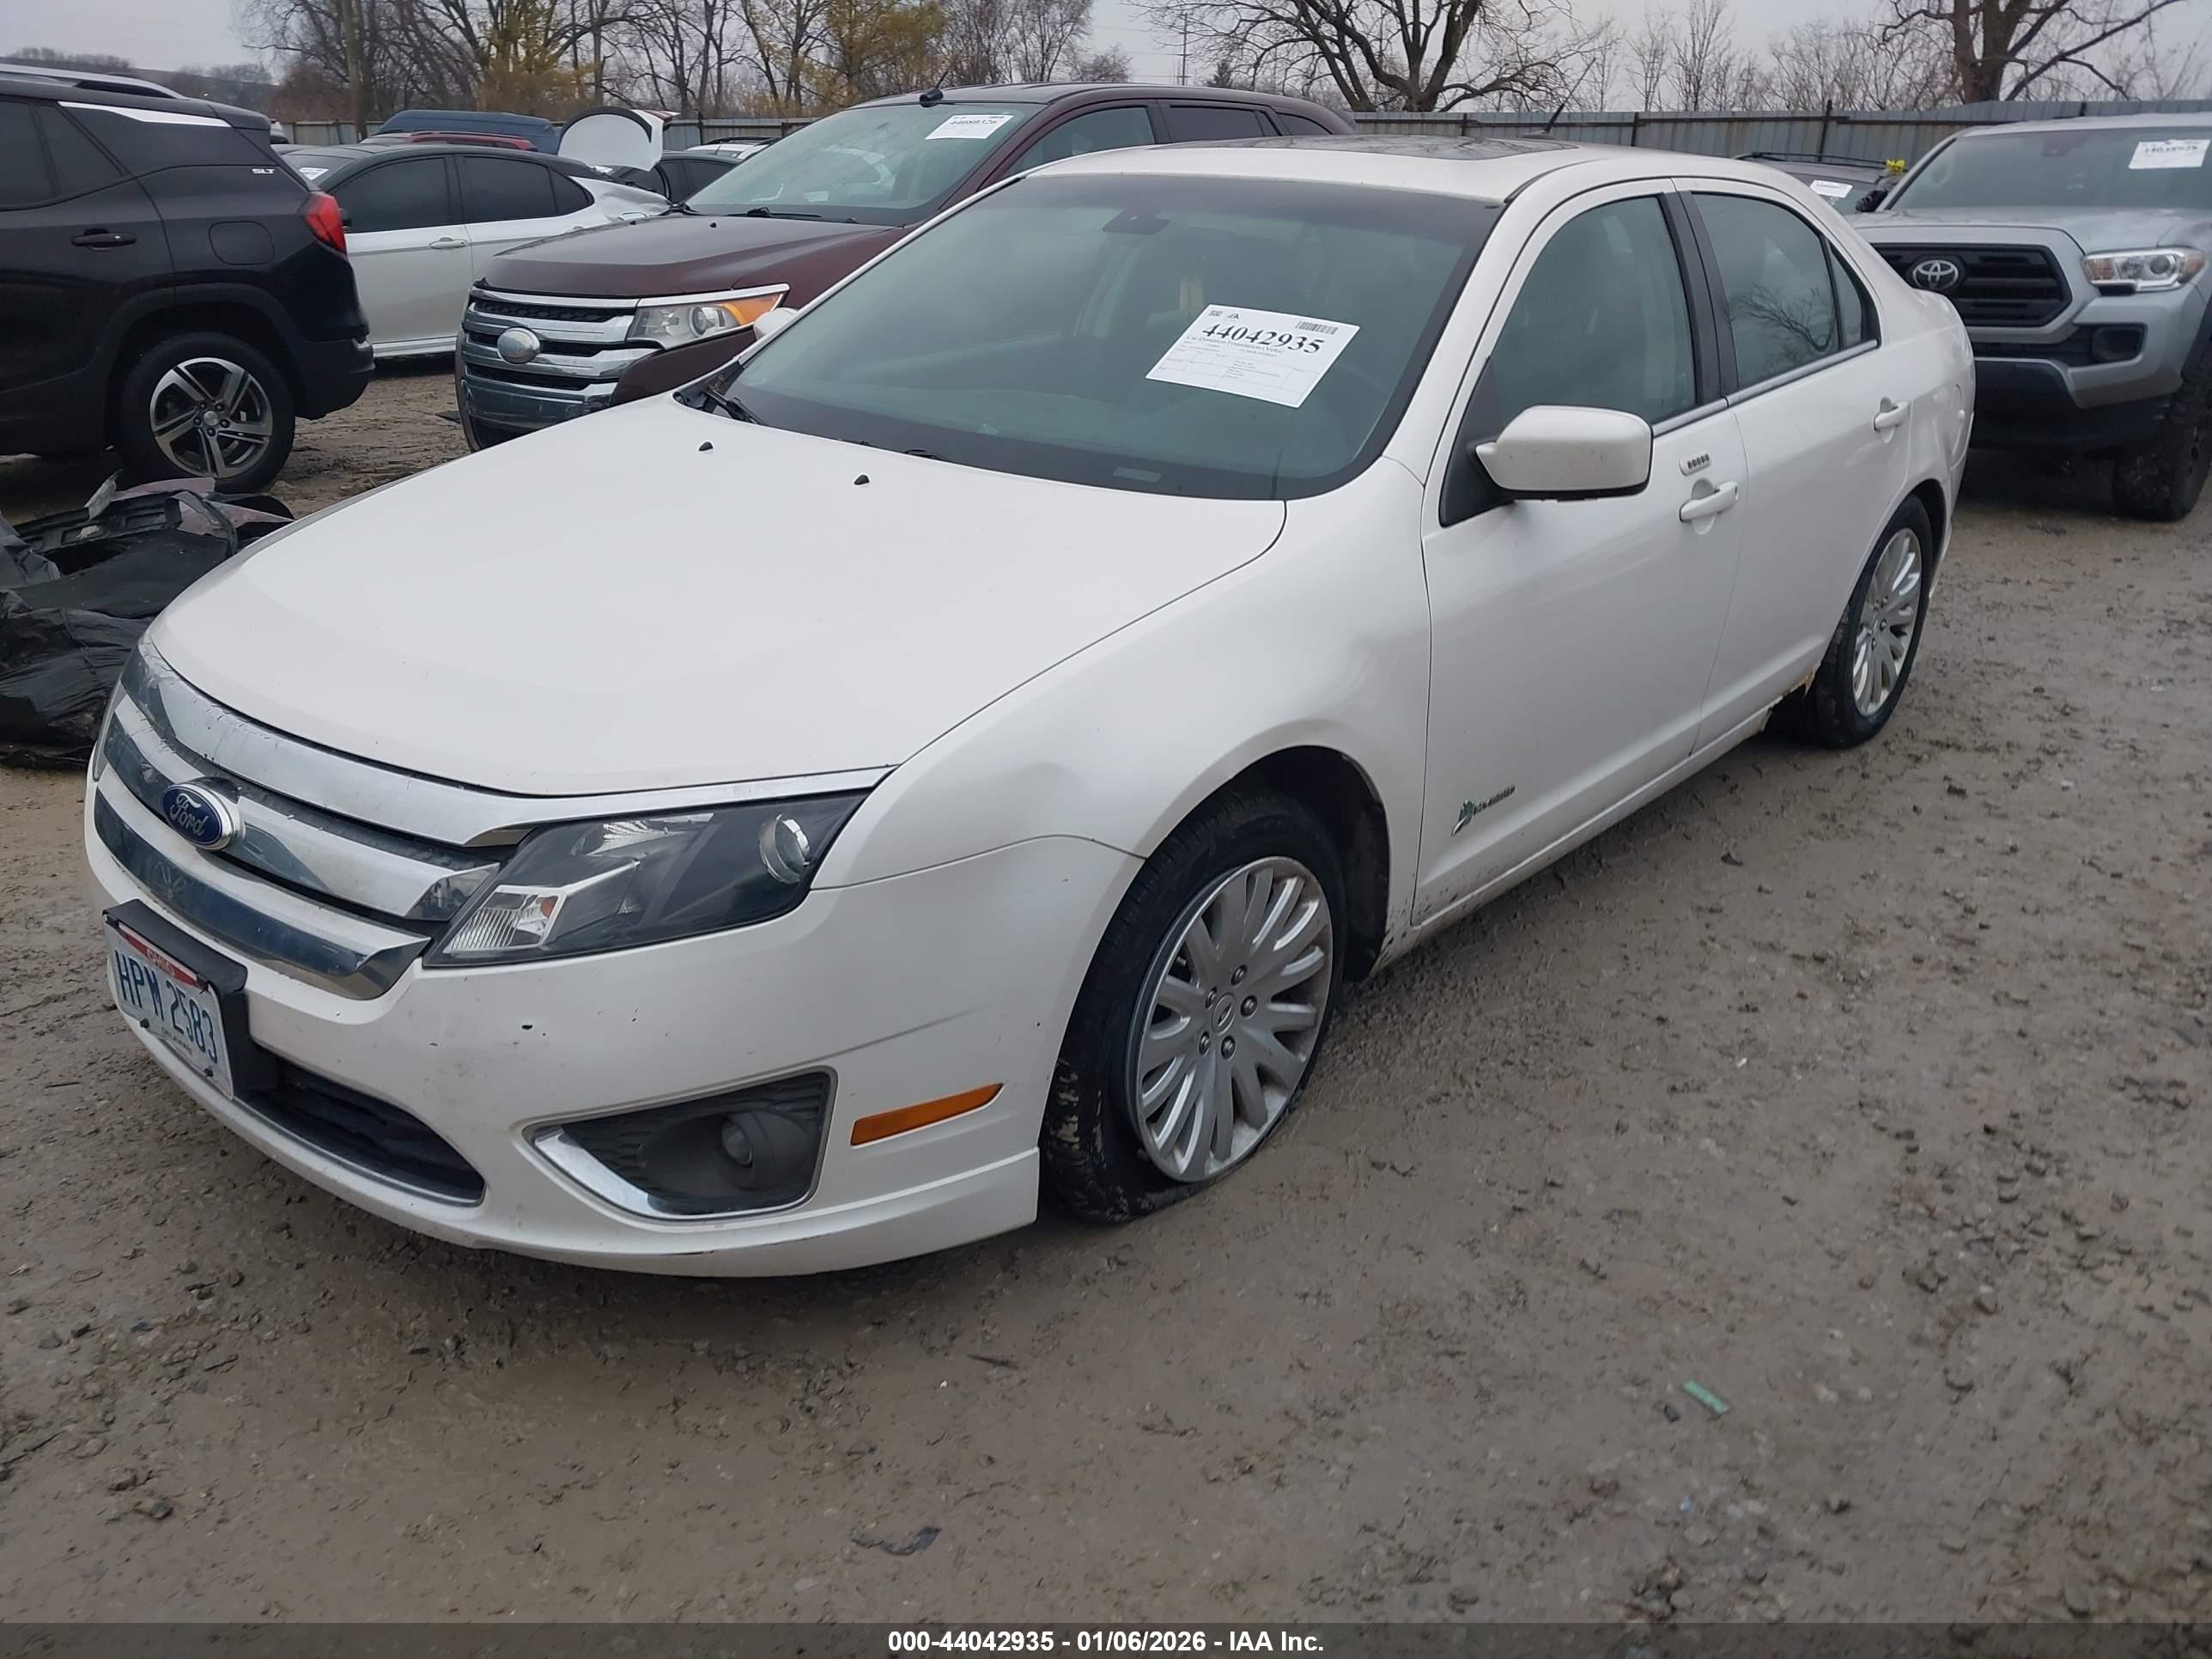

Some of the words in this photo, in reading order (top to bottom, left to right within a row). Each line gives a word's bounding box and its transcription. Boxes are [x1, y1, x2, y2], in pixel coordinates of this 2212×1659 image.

[1202, 323, 1326, 354] 44042935
[169, 793, 209, 836] Ford
[114, 950, 164, 1022] HPM
[166, 979, 218, 1064] 2583
